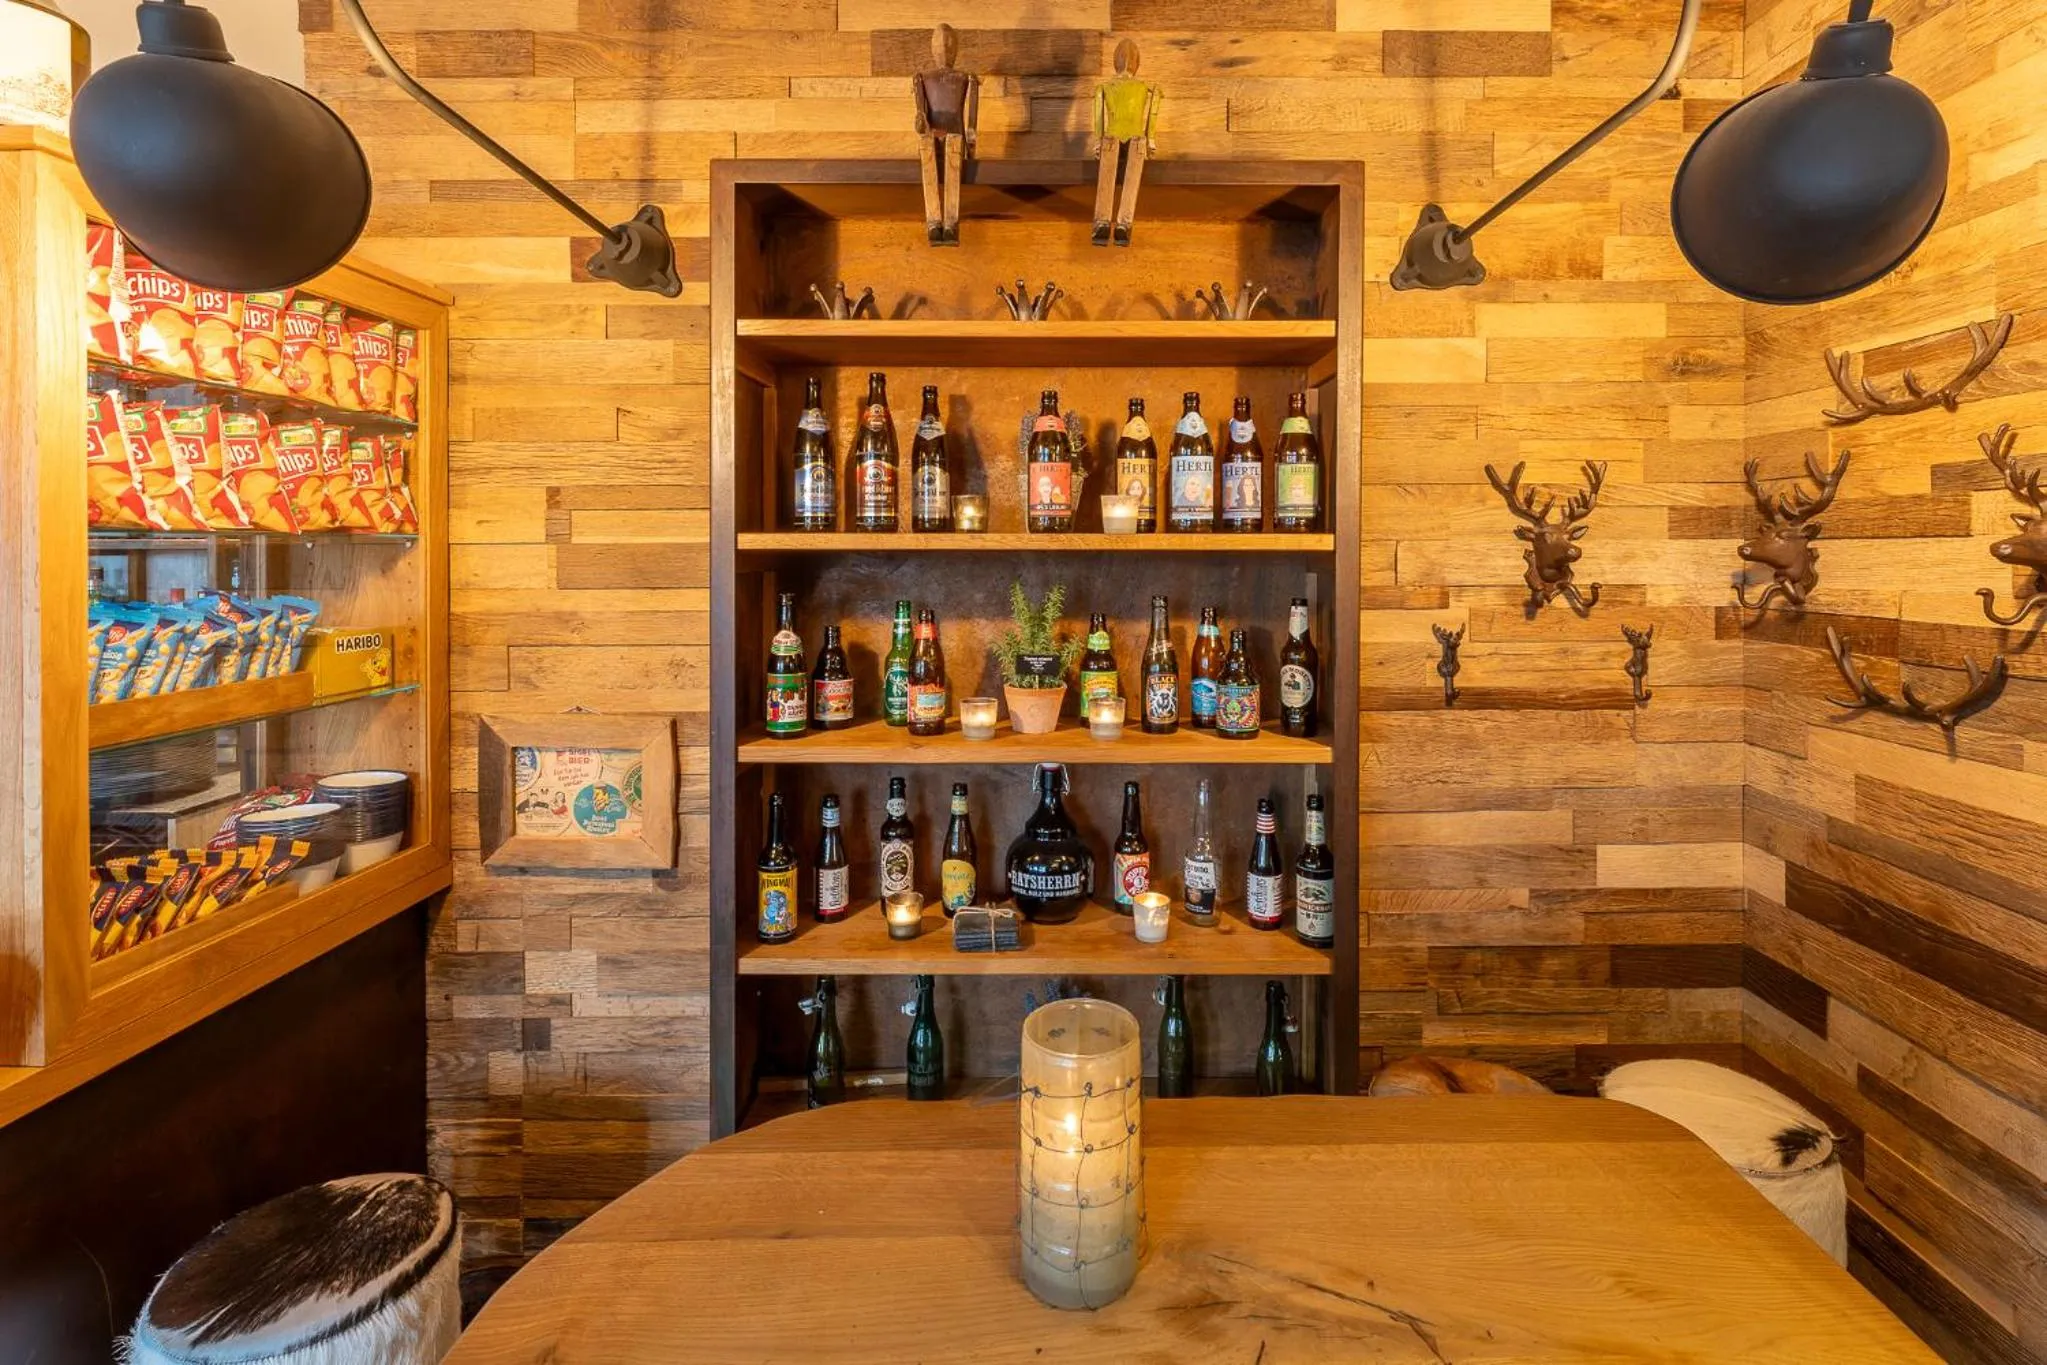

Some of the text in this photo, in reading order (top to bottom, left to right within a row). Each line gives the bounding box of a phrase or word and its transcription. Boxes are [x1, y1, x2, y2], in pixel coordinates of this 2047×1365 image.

[127, 272, 181, 299] chips
[194, 290, 224, 311] ips
[244, 308, 270, 329] ips
[285, 314, 319, 338] hips
[229, 444, 255, 466] ips
[278, 449, 314, 473] hips
[336, 634, 382, 652] HARIBO
[1011, 869, 1080, 890] RATSHERRN
